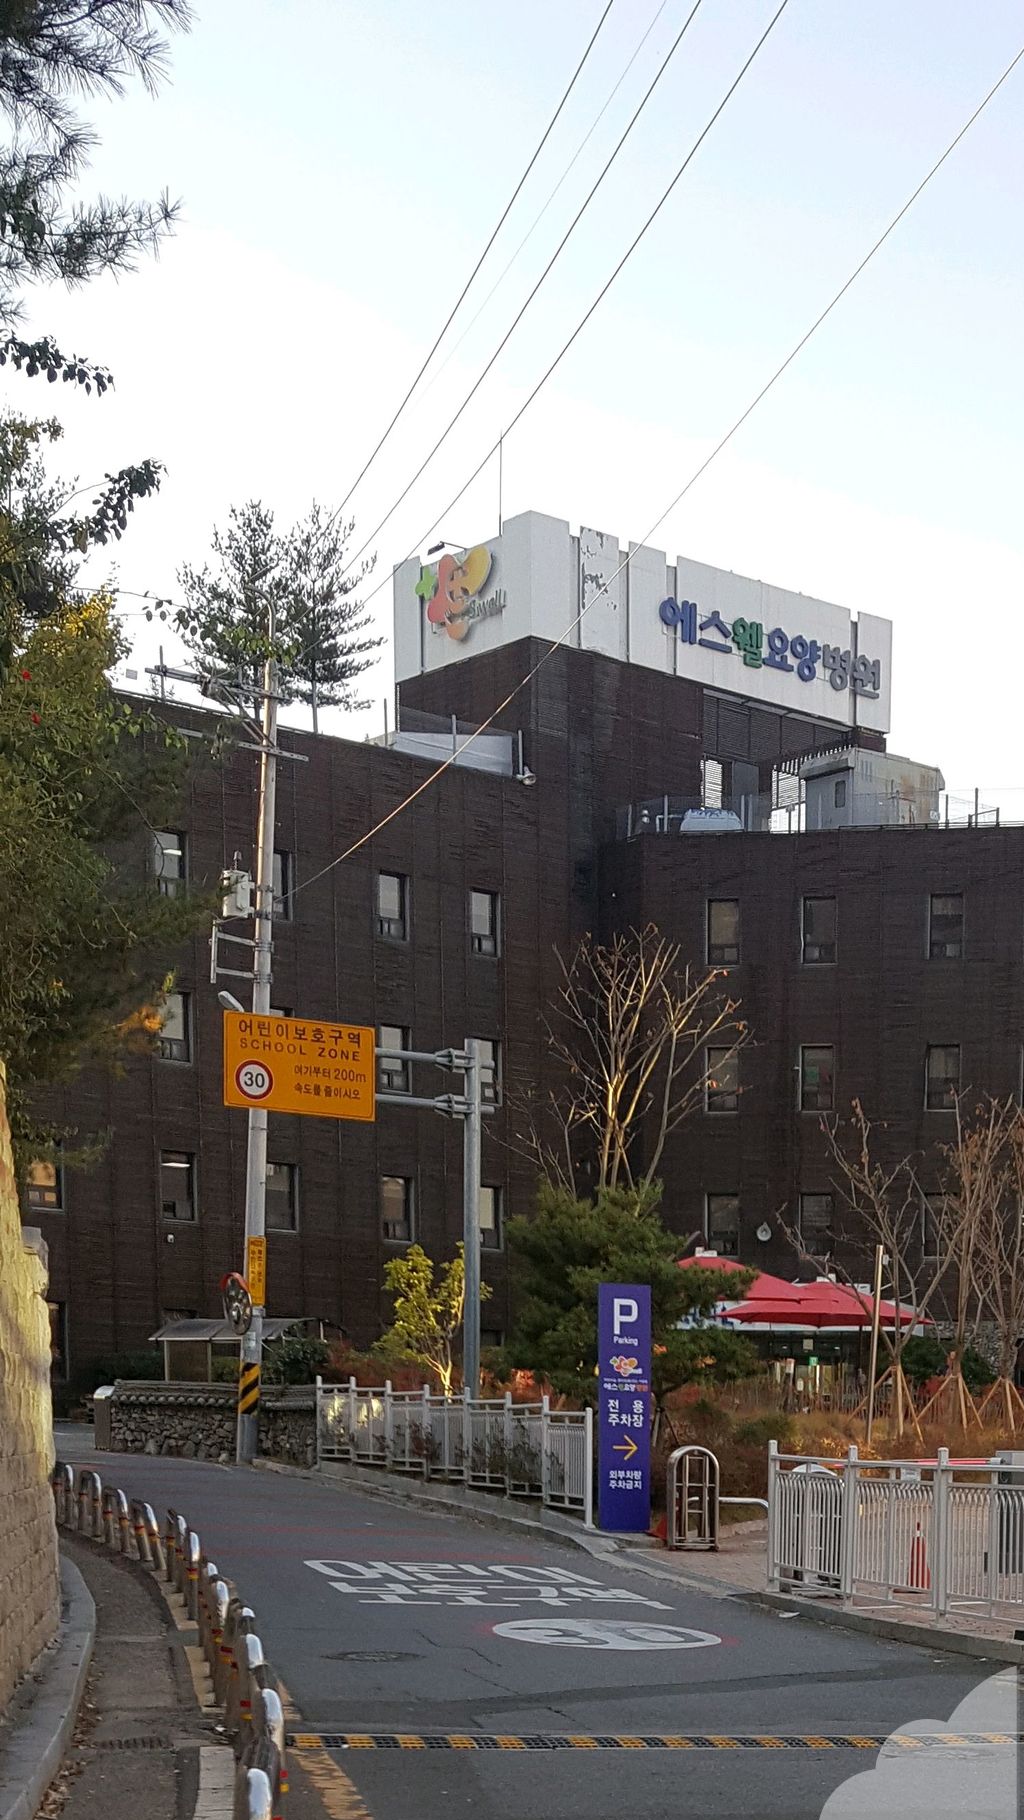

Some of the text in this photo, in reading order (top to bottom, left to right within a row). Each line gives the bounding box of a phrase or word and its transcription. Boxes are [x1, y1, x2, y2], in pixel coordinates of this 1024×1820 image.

[659, 596, 881, 699] 에스웰요양병원
[239, 1019, 361, 1048] 어린이보호구역
[240, 1038, 360, 1061] SCHOOL ZONE
[243, 1071, 266, 1088] 30
[294, 1064, 366, 1083] 여기부터 200m
[294, 1082, 361, 1099] 속도를 줄이시오
[613, 1297, 639, 1335] P
[613, 1336, 639, 1347] Parking
[608, 1413, 644, 1428] 주차장
[609, 1469, 642, 1480] 외부차량
[609, 1480, 642, 1490] 주차금지
[303, 1559, 604, 1586] 어린이
[328, 1582, 677, 1610] 보호구역
[508, 1626, 696, 1647] 30
